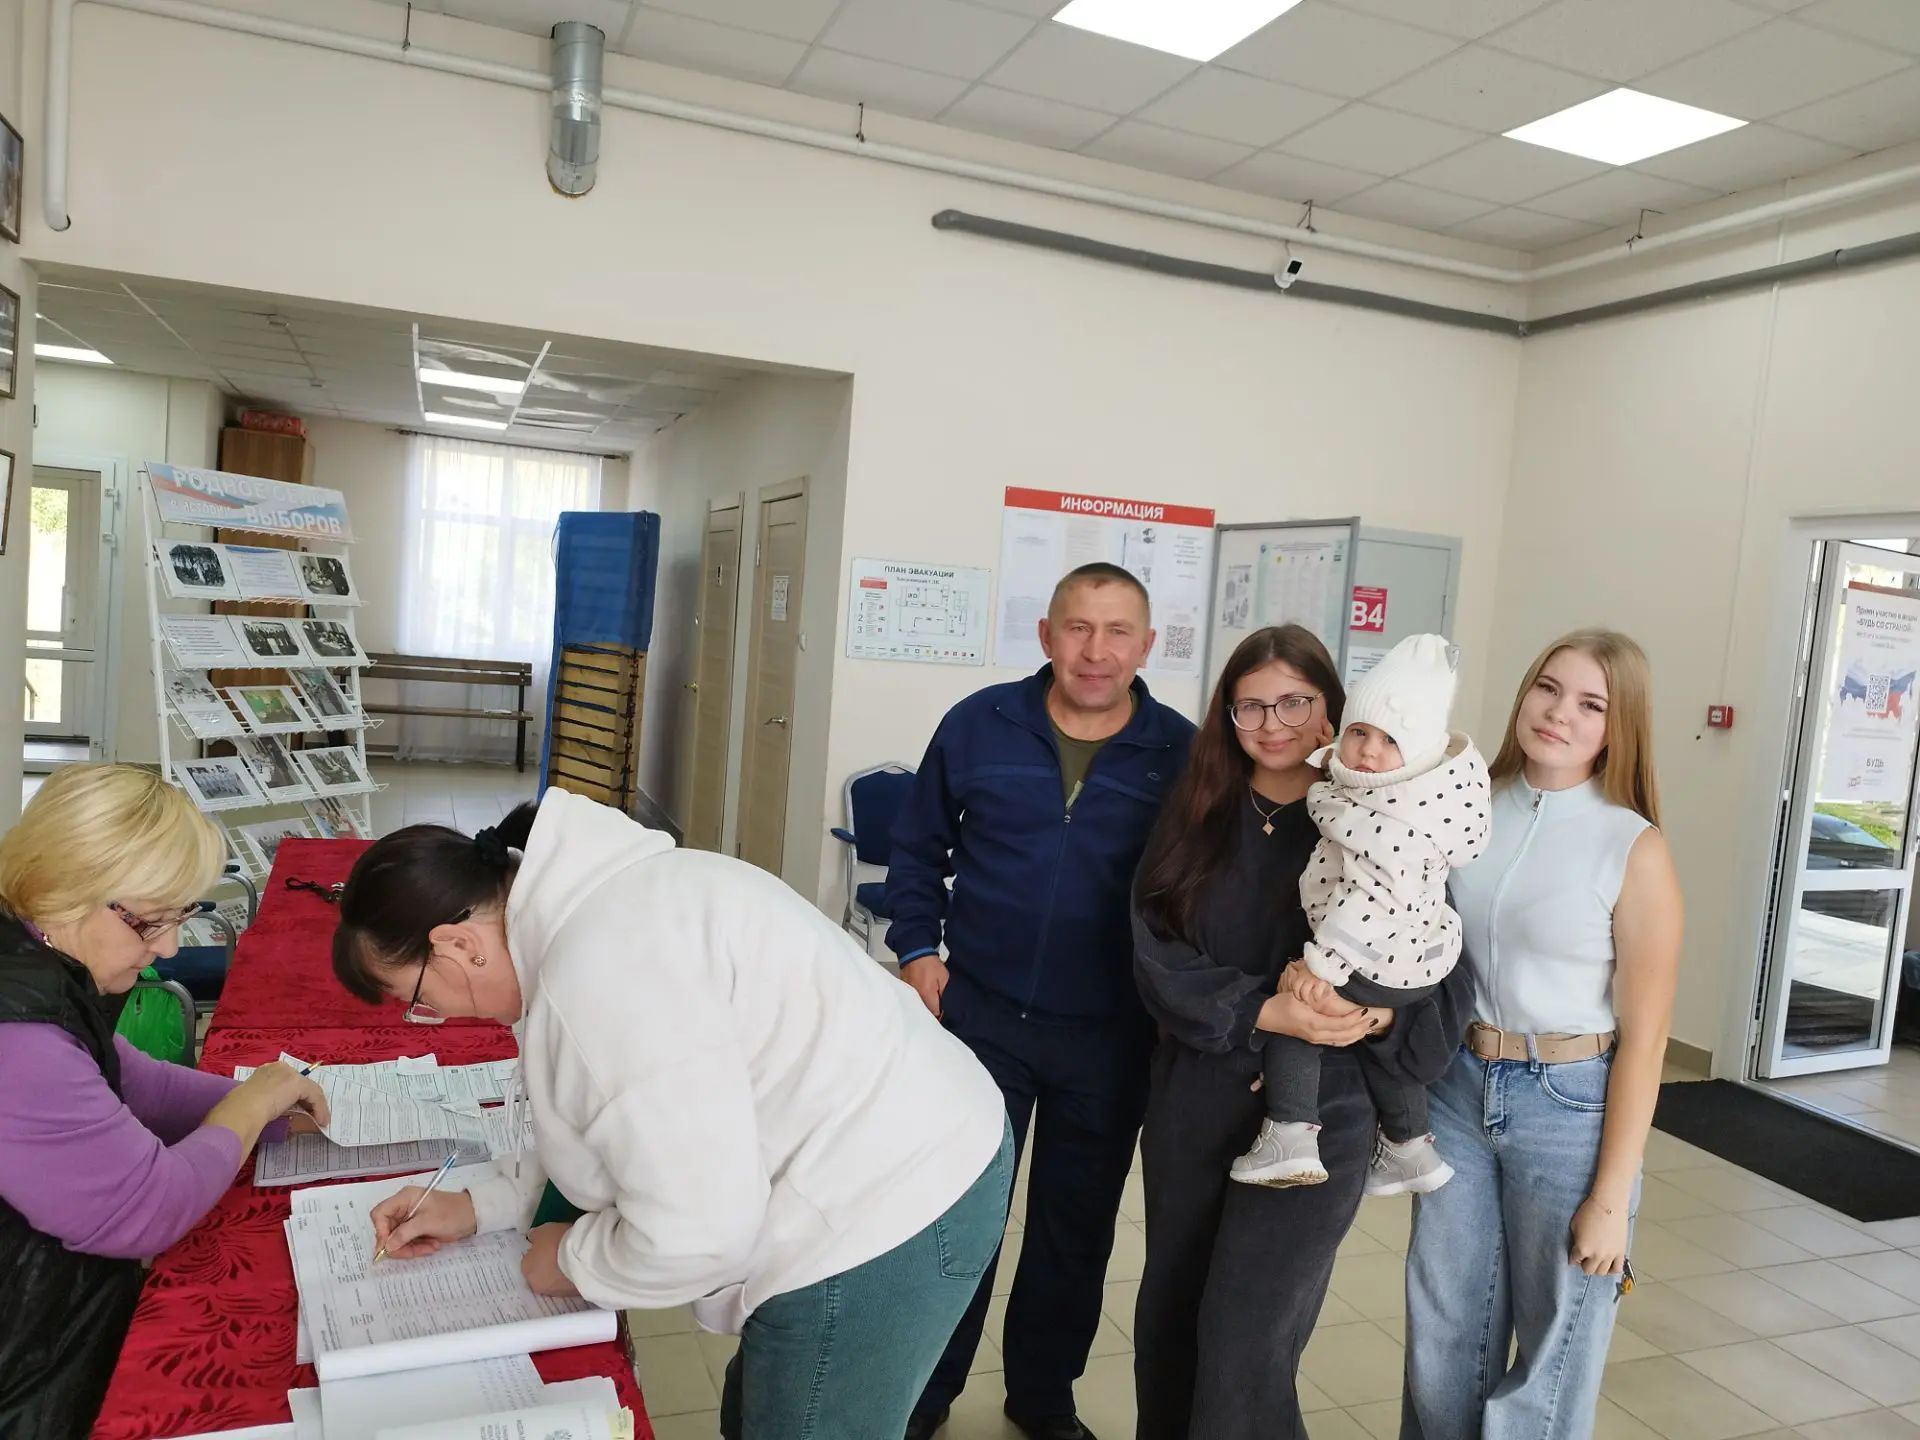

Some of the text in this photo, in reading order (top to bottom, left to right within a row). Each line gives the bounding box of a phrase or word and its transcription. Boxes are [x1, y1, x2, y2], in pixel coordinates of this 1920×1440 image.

[172, 469, 267, 499] РОДНОЕ
[244, 504, 343, 535] ВЫБОРОВ
[1060, 495, 1164, 520] ИНФОРМАЦИЯ
[884, 566, 955, 578] ПЛАН ЭВАКУАЦИИ
[1351, 601, 1384, 628] В4
